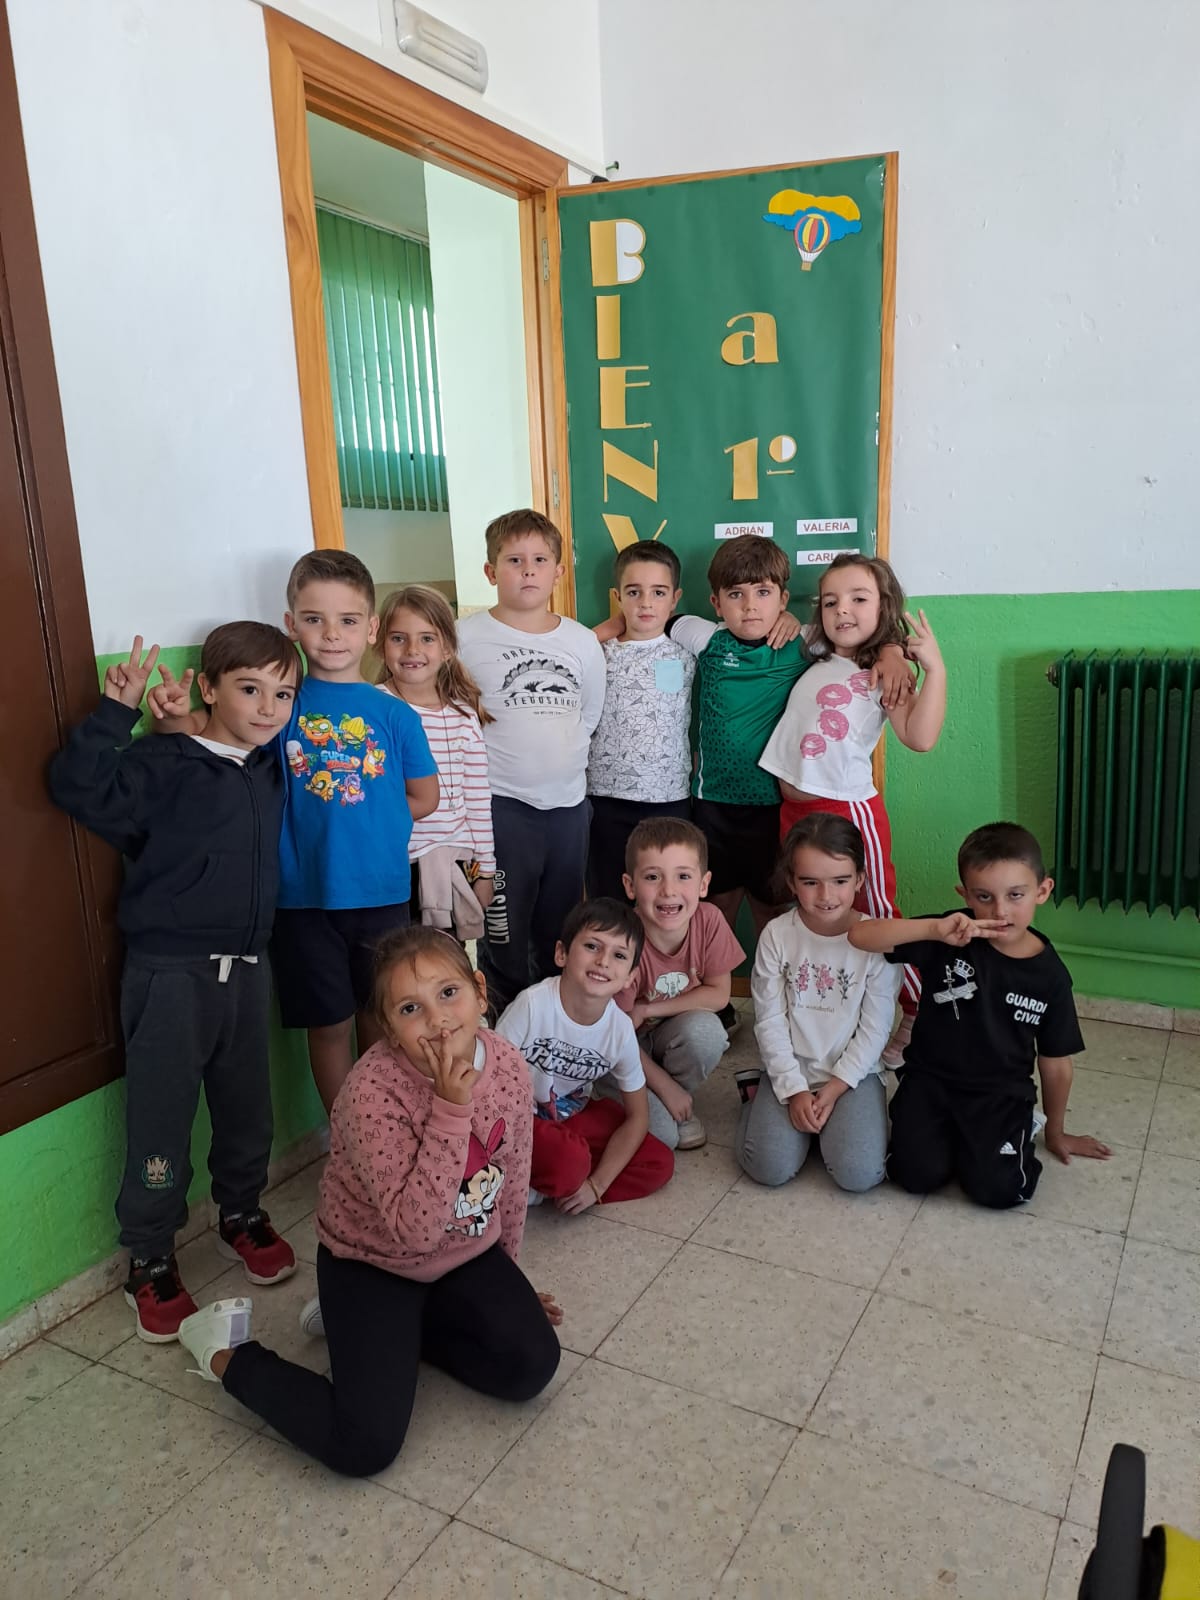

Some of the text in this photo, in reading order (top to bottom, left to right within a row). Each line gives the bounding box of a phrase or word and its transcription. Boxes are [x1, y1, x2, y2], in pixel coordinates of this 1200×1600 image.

[721, 312, 779, 366] a
[725, 526, 764, 536] ADRIAN
[803, 521, 850, 532] VALERIA
[808, 552, 836, 562] CARL
[1013, 1009, 1041, 1025] CIVIL
